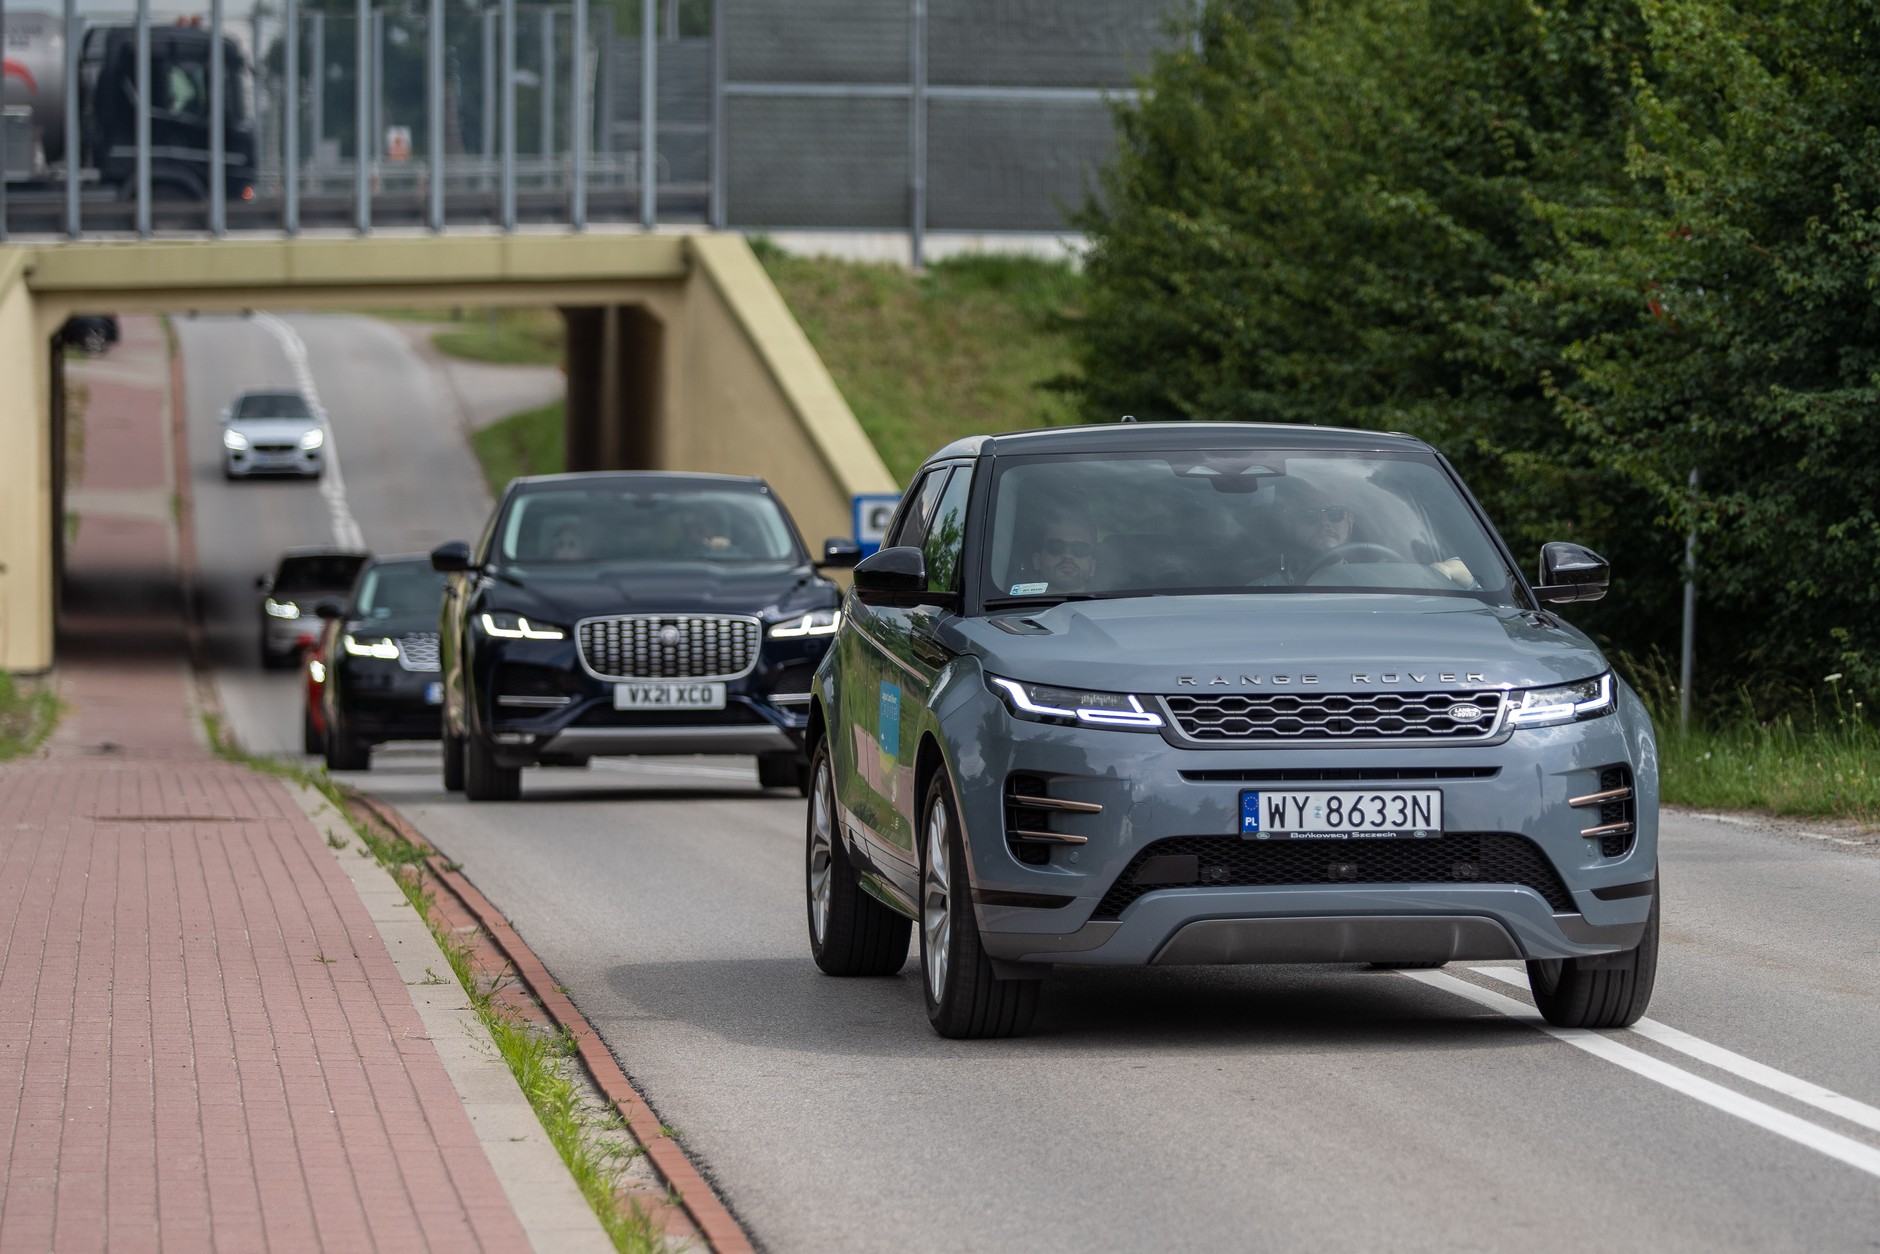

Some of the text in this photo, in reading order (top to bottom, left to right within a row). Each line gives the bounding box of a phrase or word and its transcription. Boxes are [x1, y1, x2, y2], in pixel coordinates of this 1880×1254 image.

[1176, 672, 1486, 686] RANGE ROVER
[629, 687, 671, 704] VX21
[1267, 794, 1432, 829] WY 8633N
[1245, 817, 1257, 826] PL
